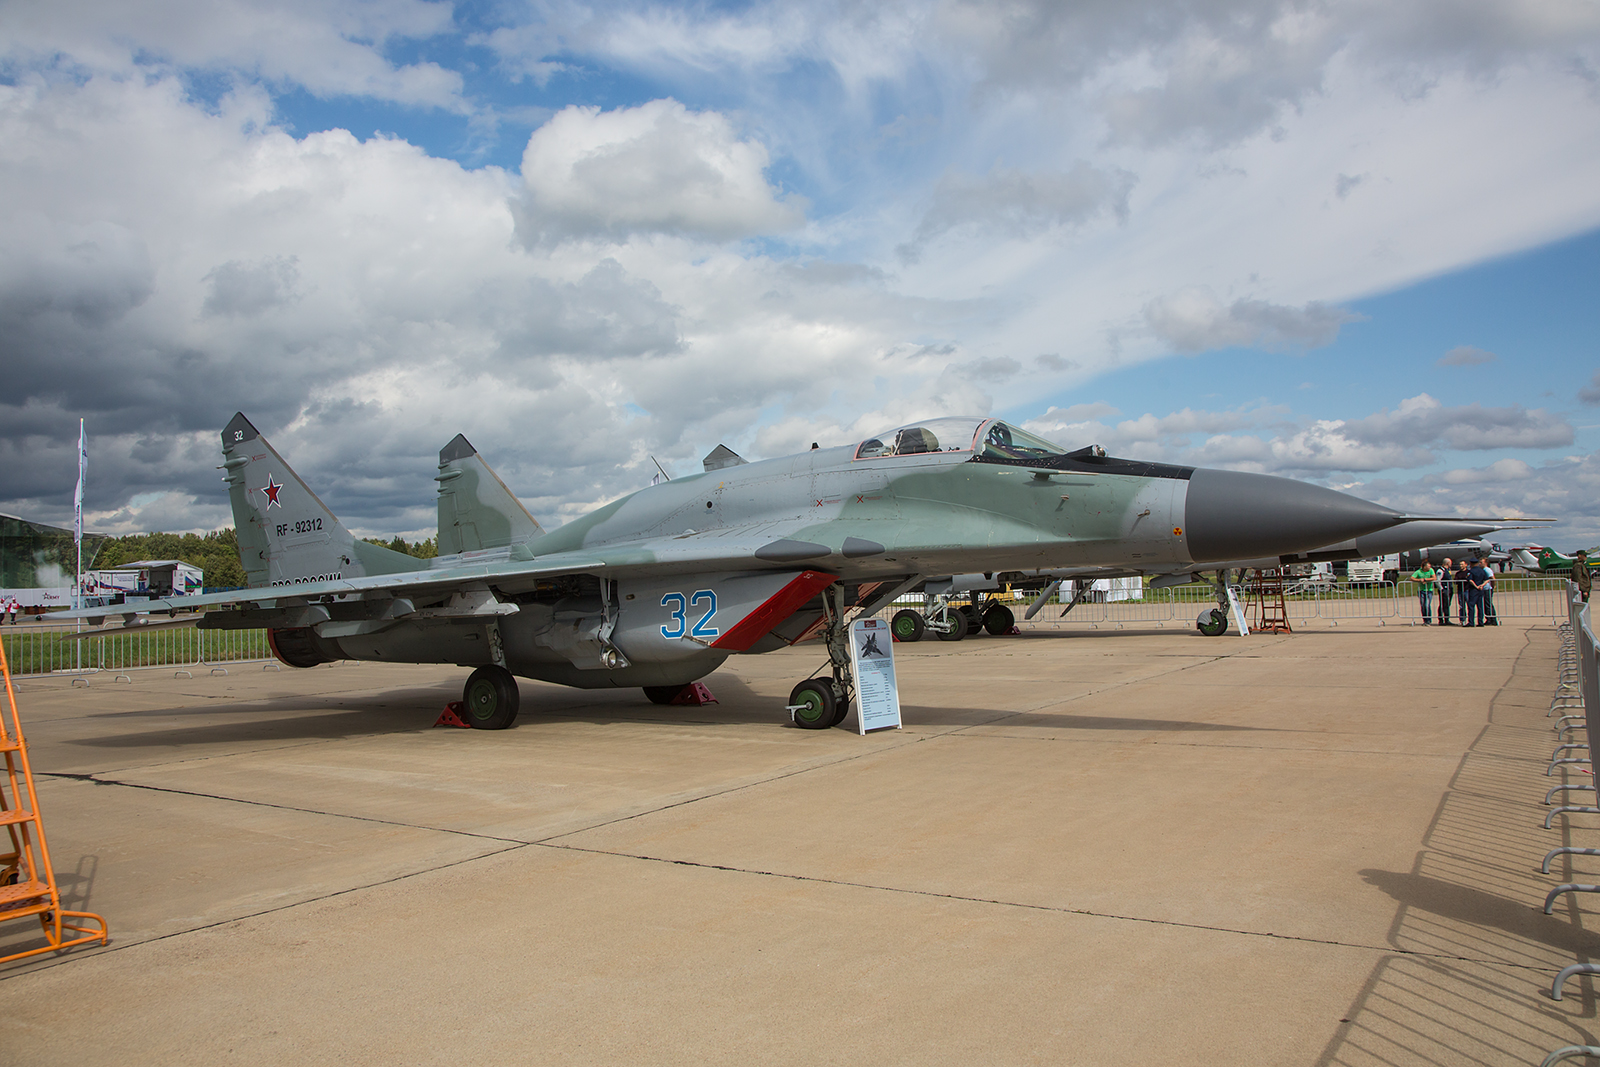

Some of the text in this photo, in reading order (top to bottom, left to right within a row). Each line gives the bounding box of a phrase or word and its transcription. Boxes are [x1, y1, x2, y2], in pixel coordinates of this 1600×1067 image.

[235, 430, 243, 441] 32
[276, 524, 288, 536] RF
[295, 518, 323, 534] 92312
[660, 589, 720, 640] 32
